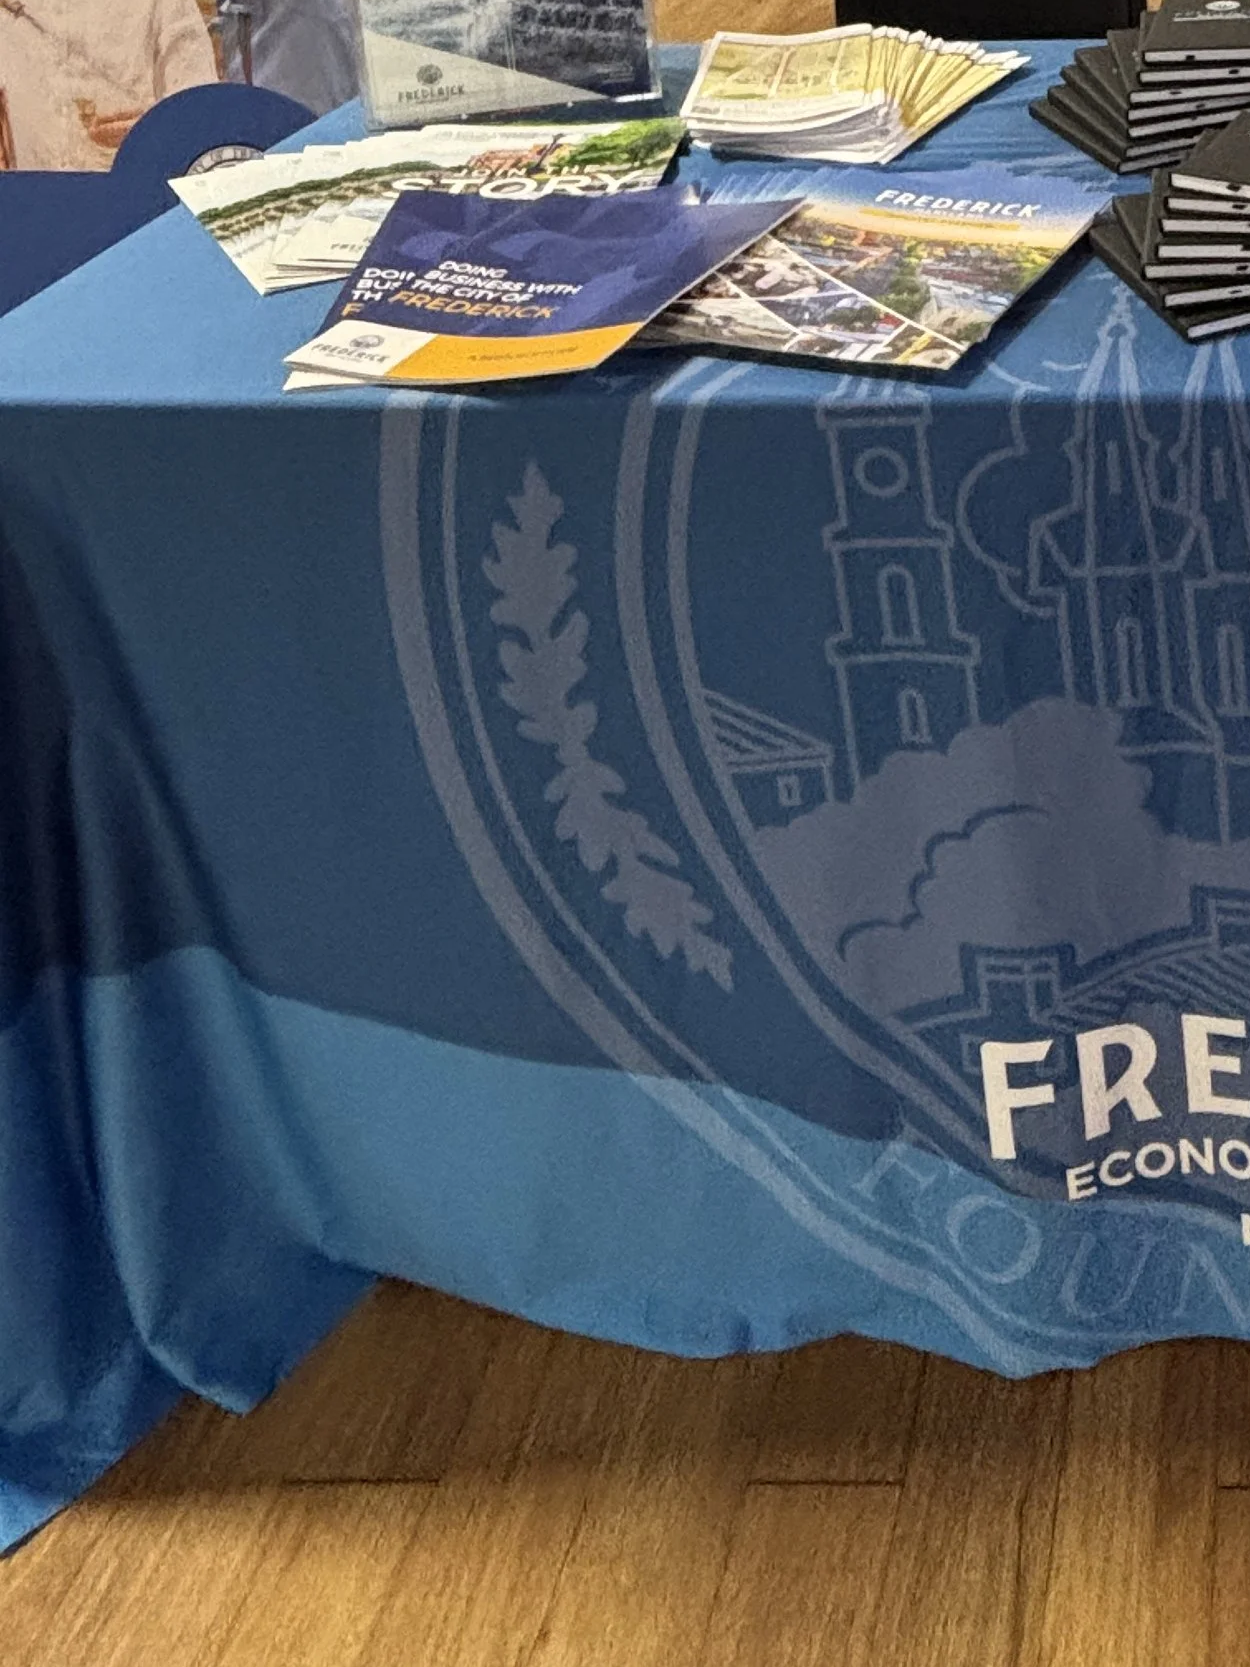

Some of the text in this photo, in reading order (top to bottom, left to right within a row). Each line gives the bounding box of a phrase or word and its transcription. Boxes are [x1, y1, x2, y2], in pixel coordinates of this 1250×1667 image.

[381, 169, 646, 200] STORY
[453, 167, 526, 177] JOIN
[875, 190, 1041, 217] FREDERICK
[439, 260, 509, 279] DOING
[412, 279, 454, 295] THE
[453, 287, 502, 303] CITY
[502, 293, 534, 305] OF
[424, 270, 583, 296] BUSINESS WITH
[388, 290, 561, 319] FREDERICK
[312, 343, 390, 365] FREDERICK
